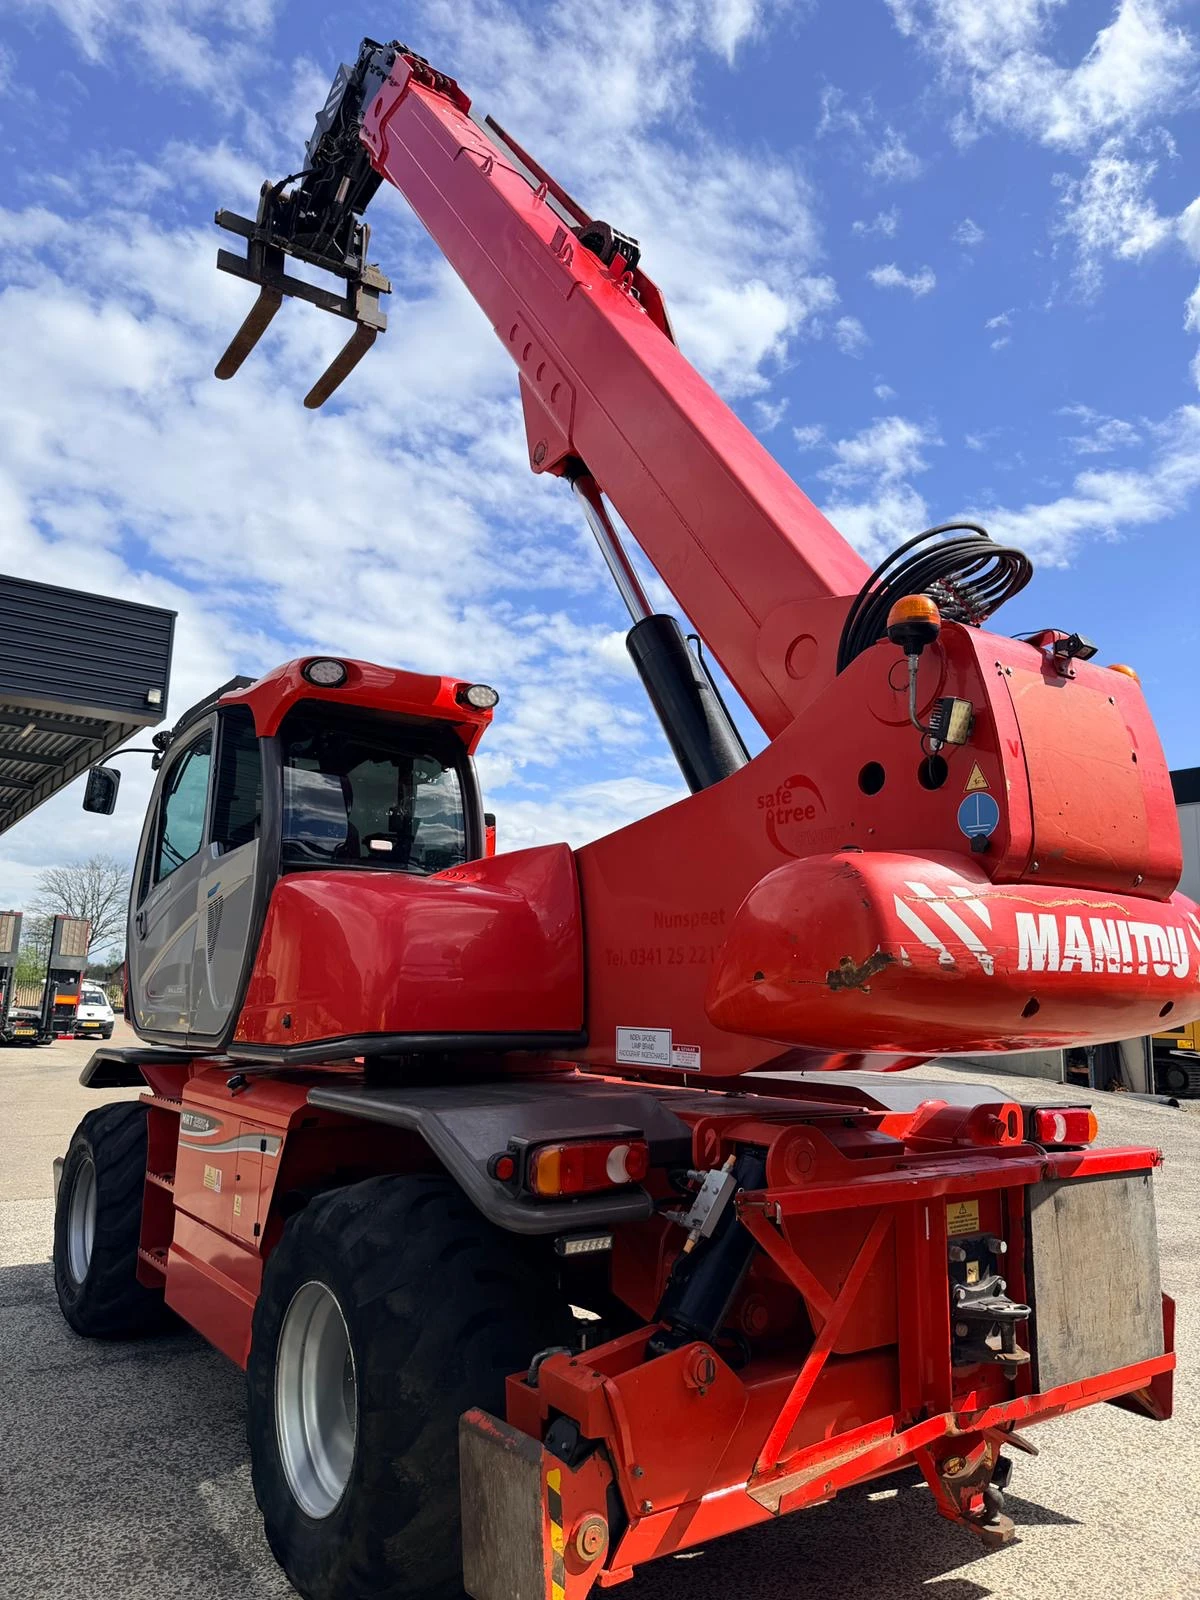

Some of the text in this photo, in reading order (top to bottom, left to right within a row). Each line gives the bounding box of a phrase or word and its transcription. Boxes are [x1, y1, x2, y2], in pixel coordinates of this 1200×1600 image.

[757, 785, 792, 809] safe
[776, 804, 816, 825] tree
[654, 907, 726, 933] Nunspeet
[605, 946, 628, 967] Tel.
[630, 946, 662, 967] 0341
[667, 946, 685, 965] 25
[1015, 911, 1190, 979] MANITOU
